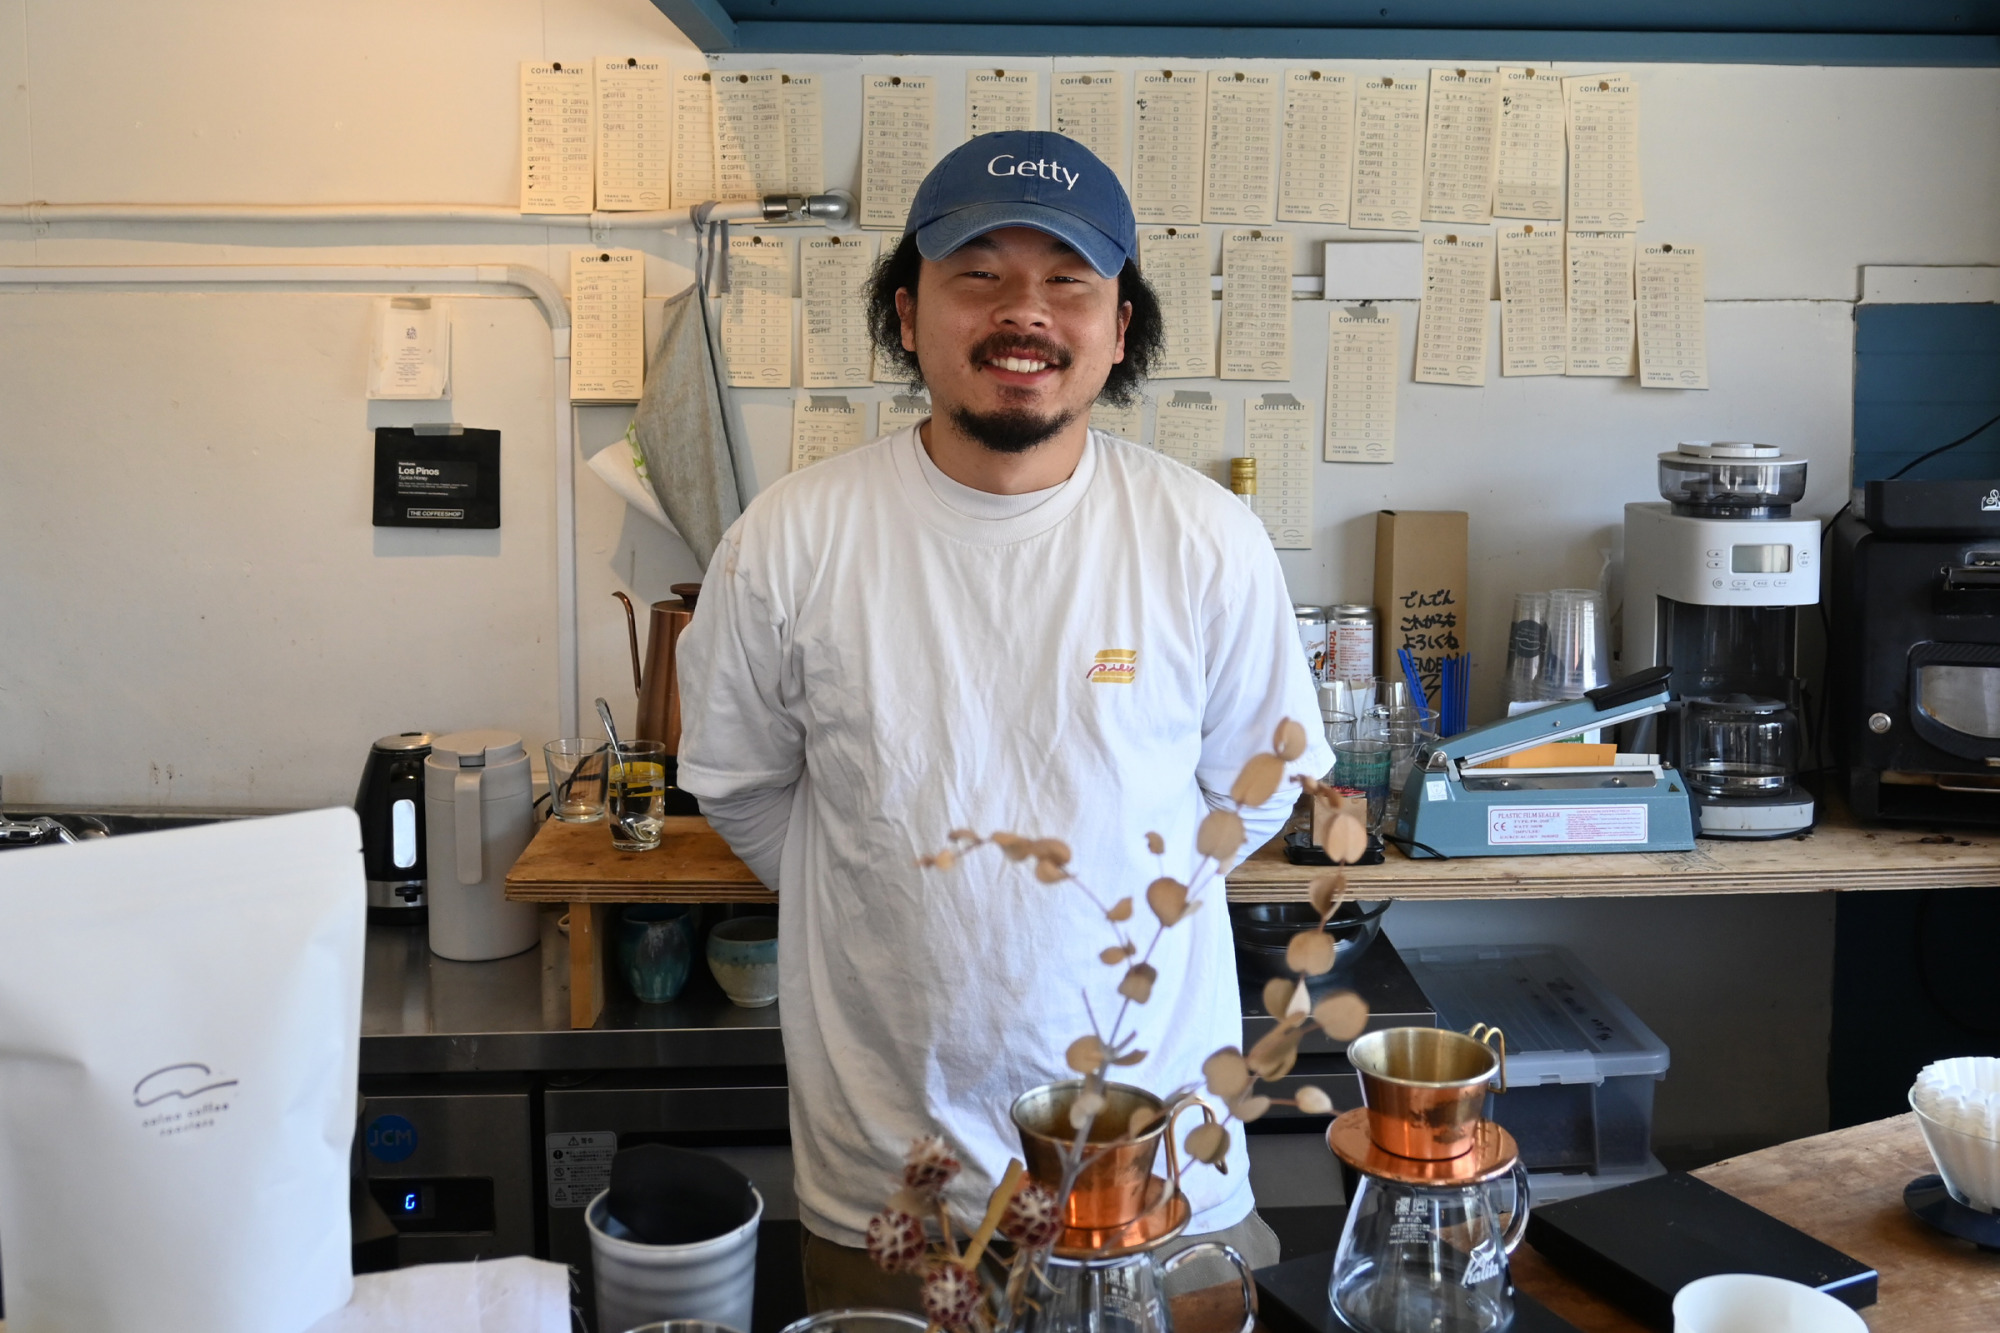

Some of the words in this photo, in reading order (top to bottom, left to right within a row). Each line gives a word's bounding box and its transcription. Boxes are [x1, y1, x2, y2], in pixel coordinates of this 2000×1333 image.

[988, 154, 1080, 191] Getty
[1167, 401, 1192, 409] COFFEE
[1195, 402, 1218, 411] TICKET
[399, 466, 414, 474] Los
[416, 467, 439, 475] Pinos
[1400, 589, 1455, 608] でんでん
[1400, 612, 1456, 632] これからも
[1403, 631, 1459, 650] よろしくね
[1403, 652, 1459, 673] ENDE
[370, 1130, 412, 1146] JCM
[1460, 1240, 1500, 1288] Kalita
